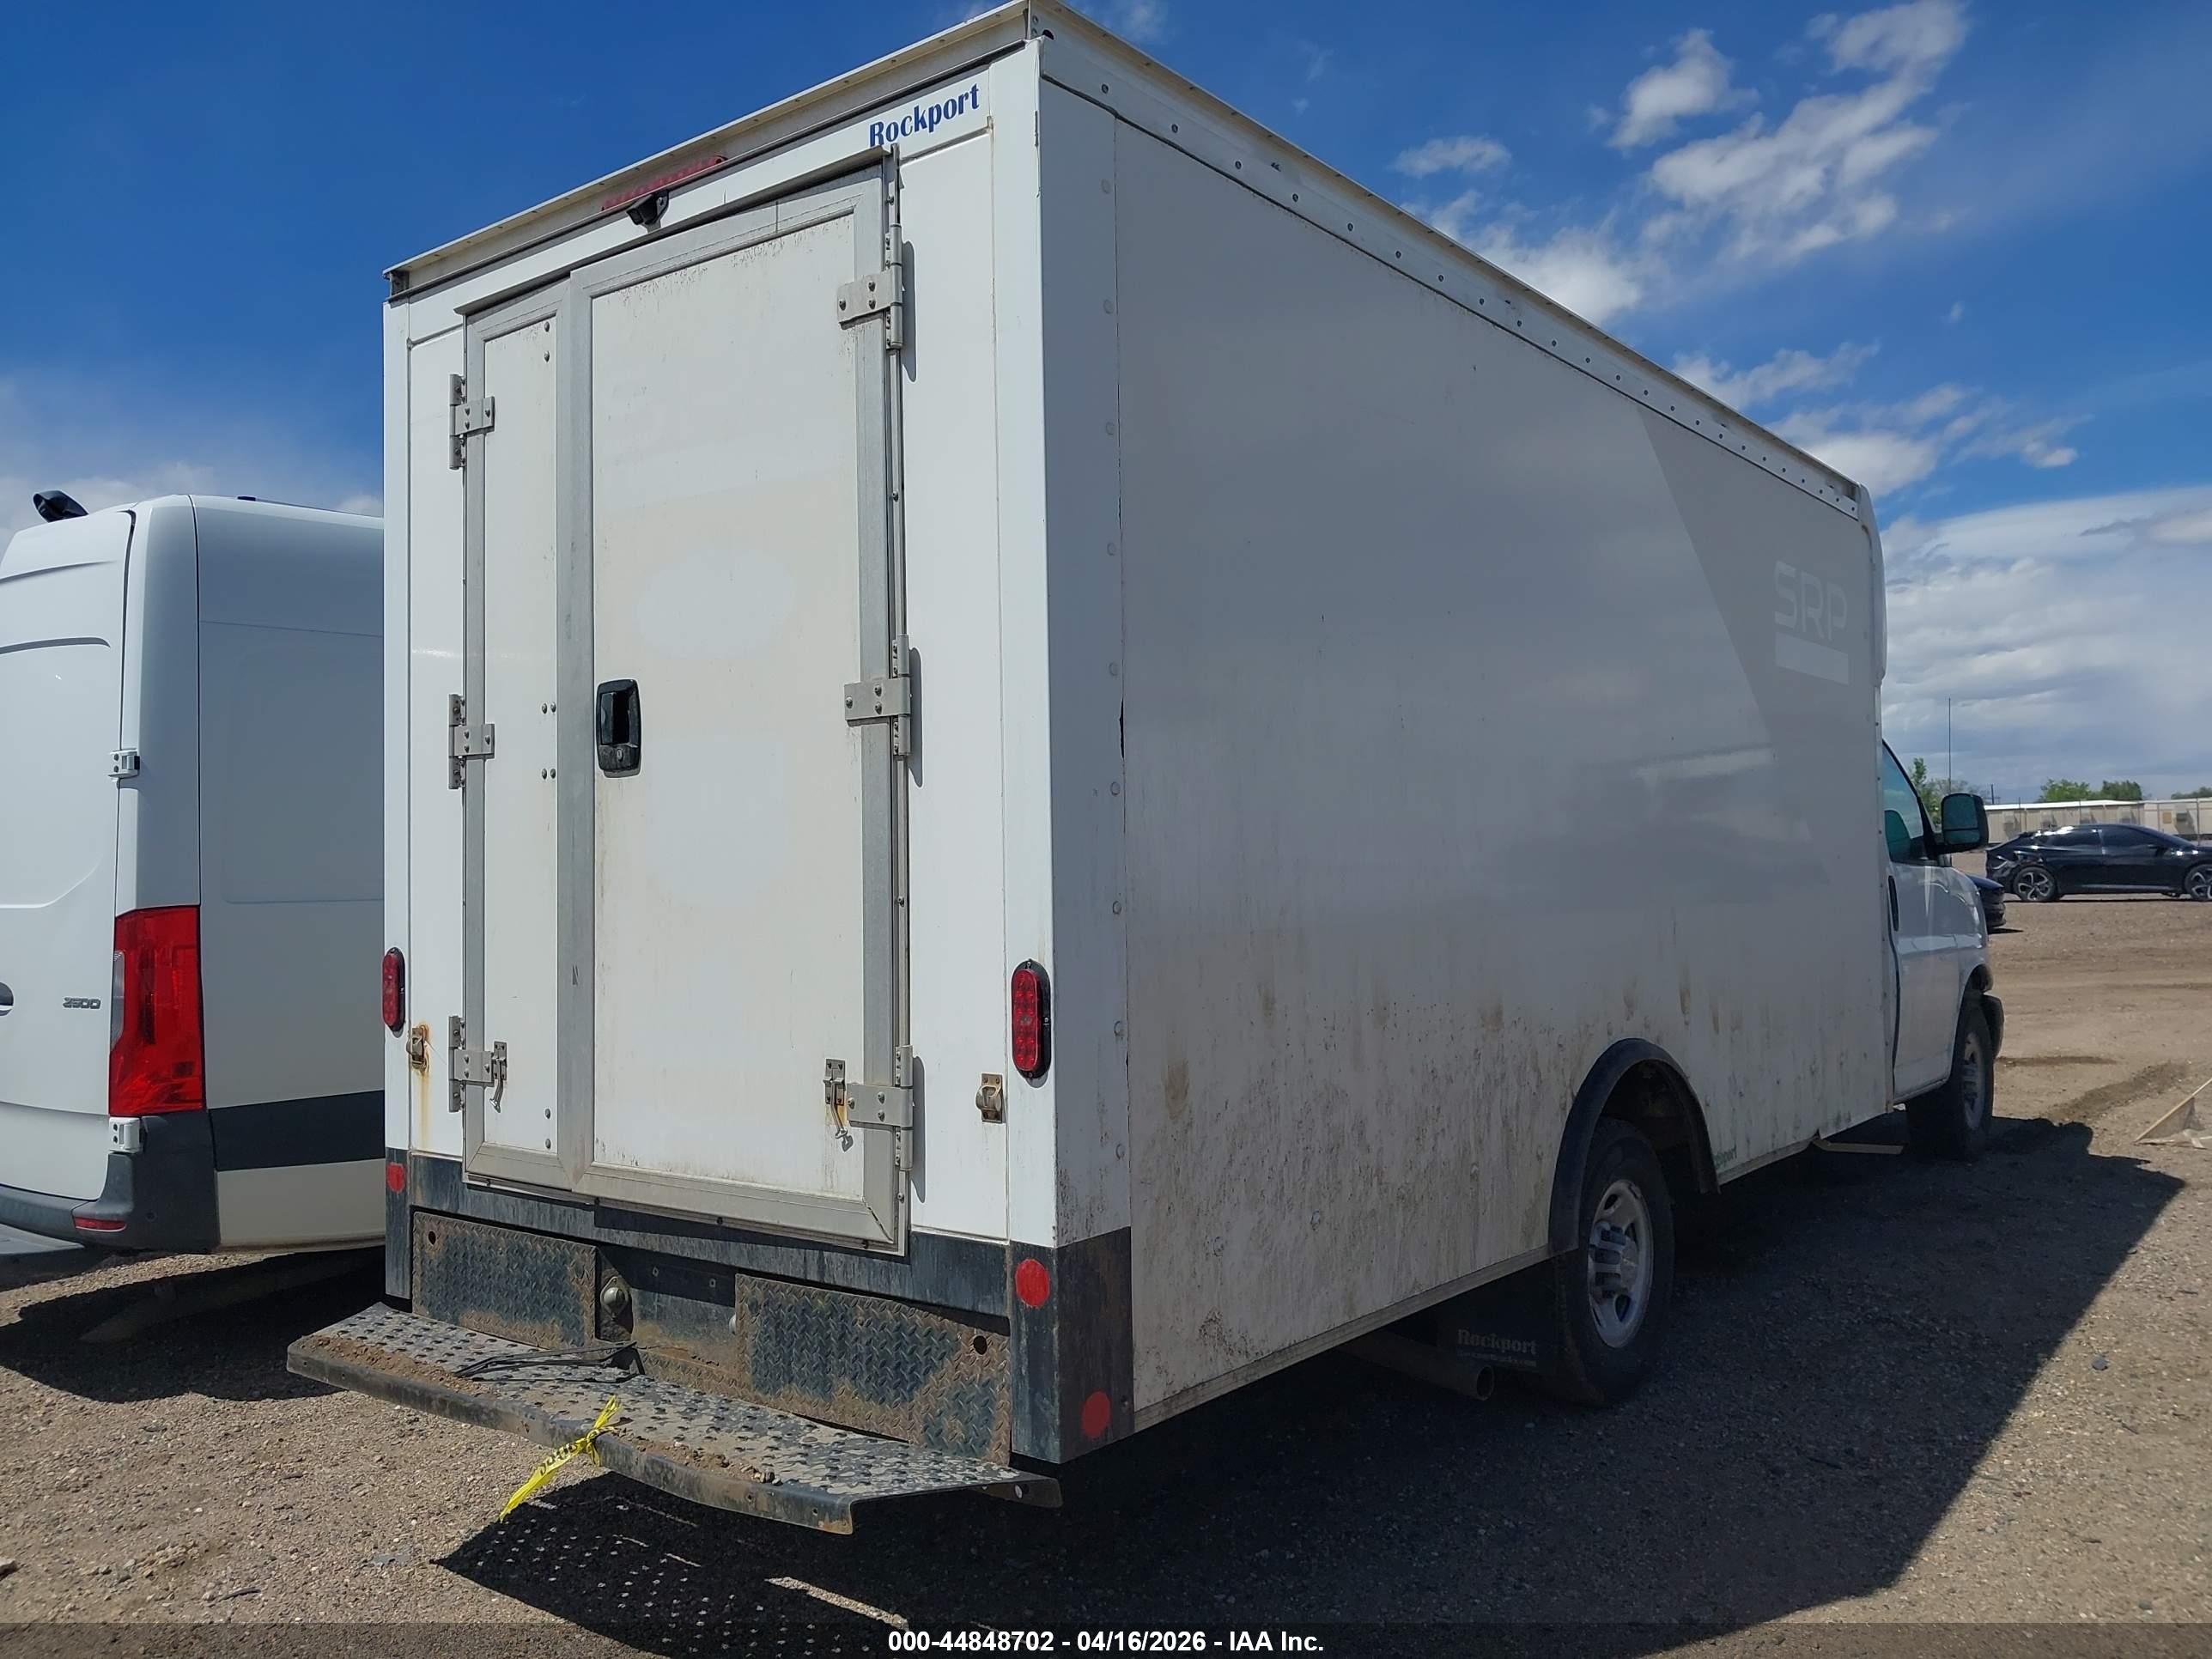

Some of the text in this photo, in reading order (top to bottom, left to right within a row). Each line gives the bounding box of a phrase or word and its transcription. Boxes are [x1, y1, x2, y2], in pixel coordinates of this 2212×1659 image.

[869, 83, 980, 148] Rockport
[1774, 561, 1847, 641] SRP
[1457, 1328, 1538, 1356] Rockport
